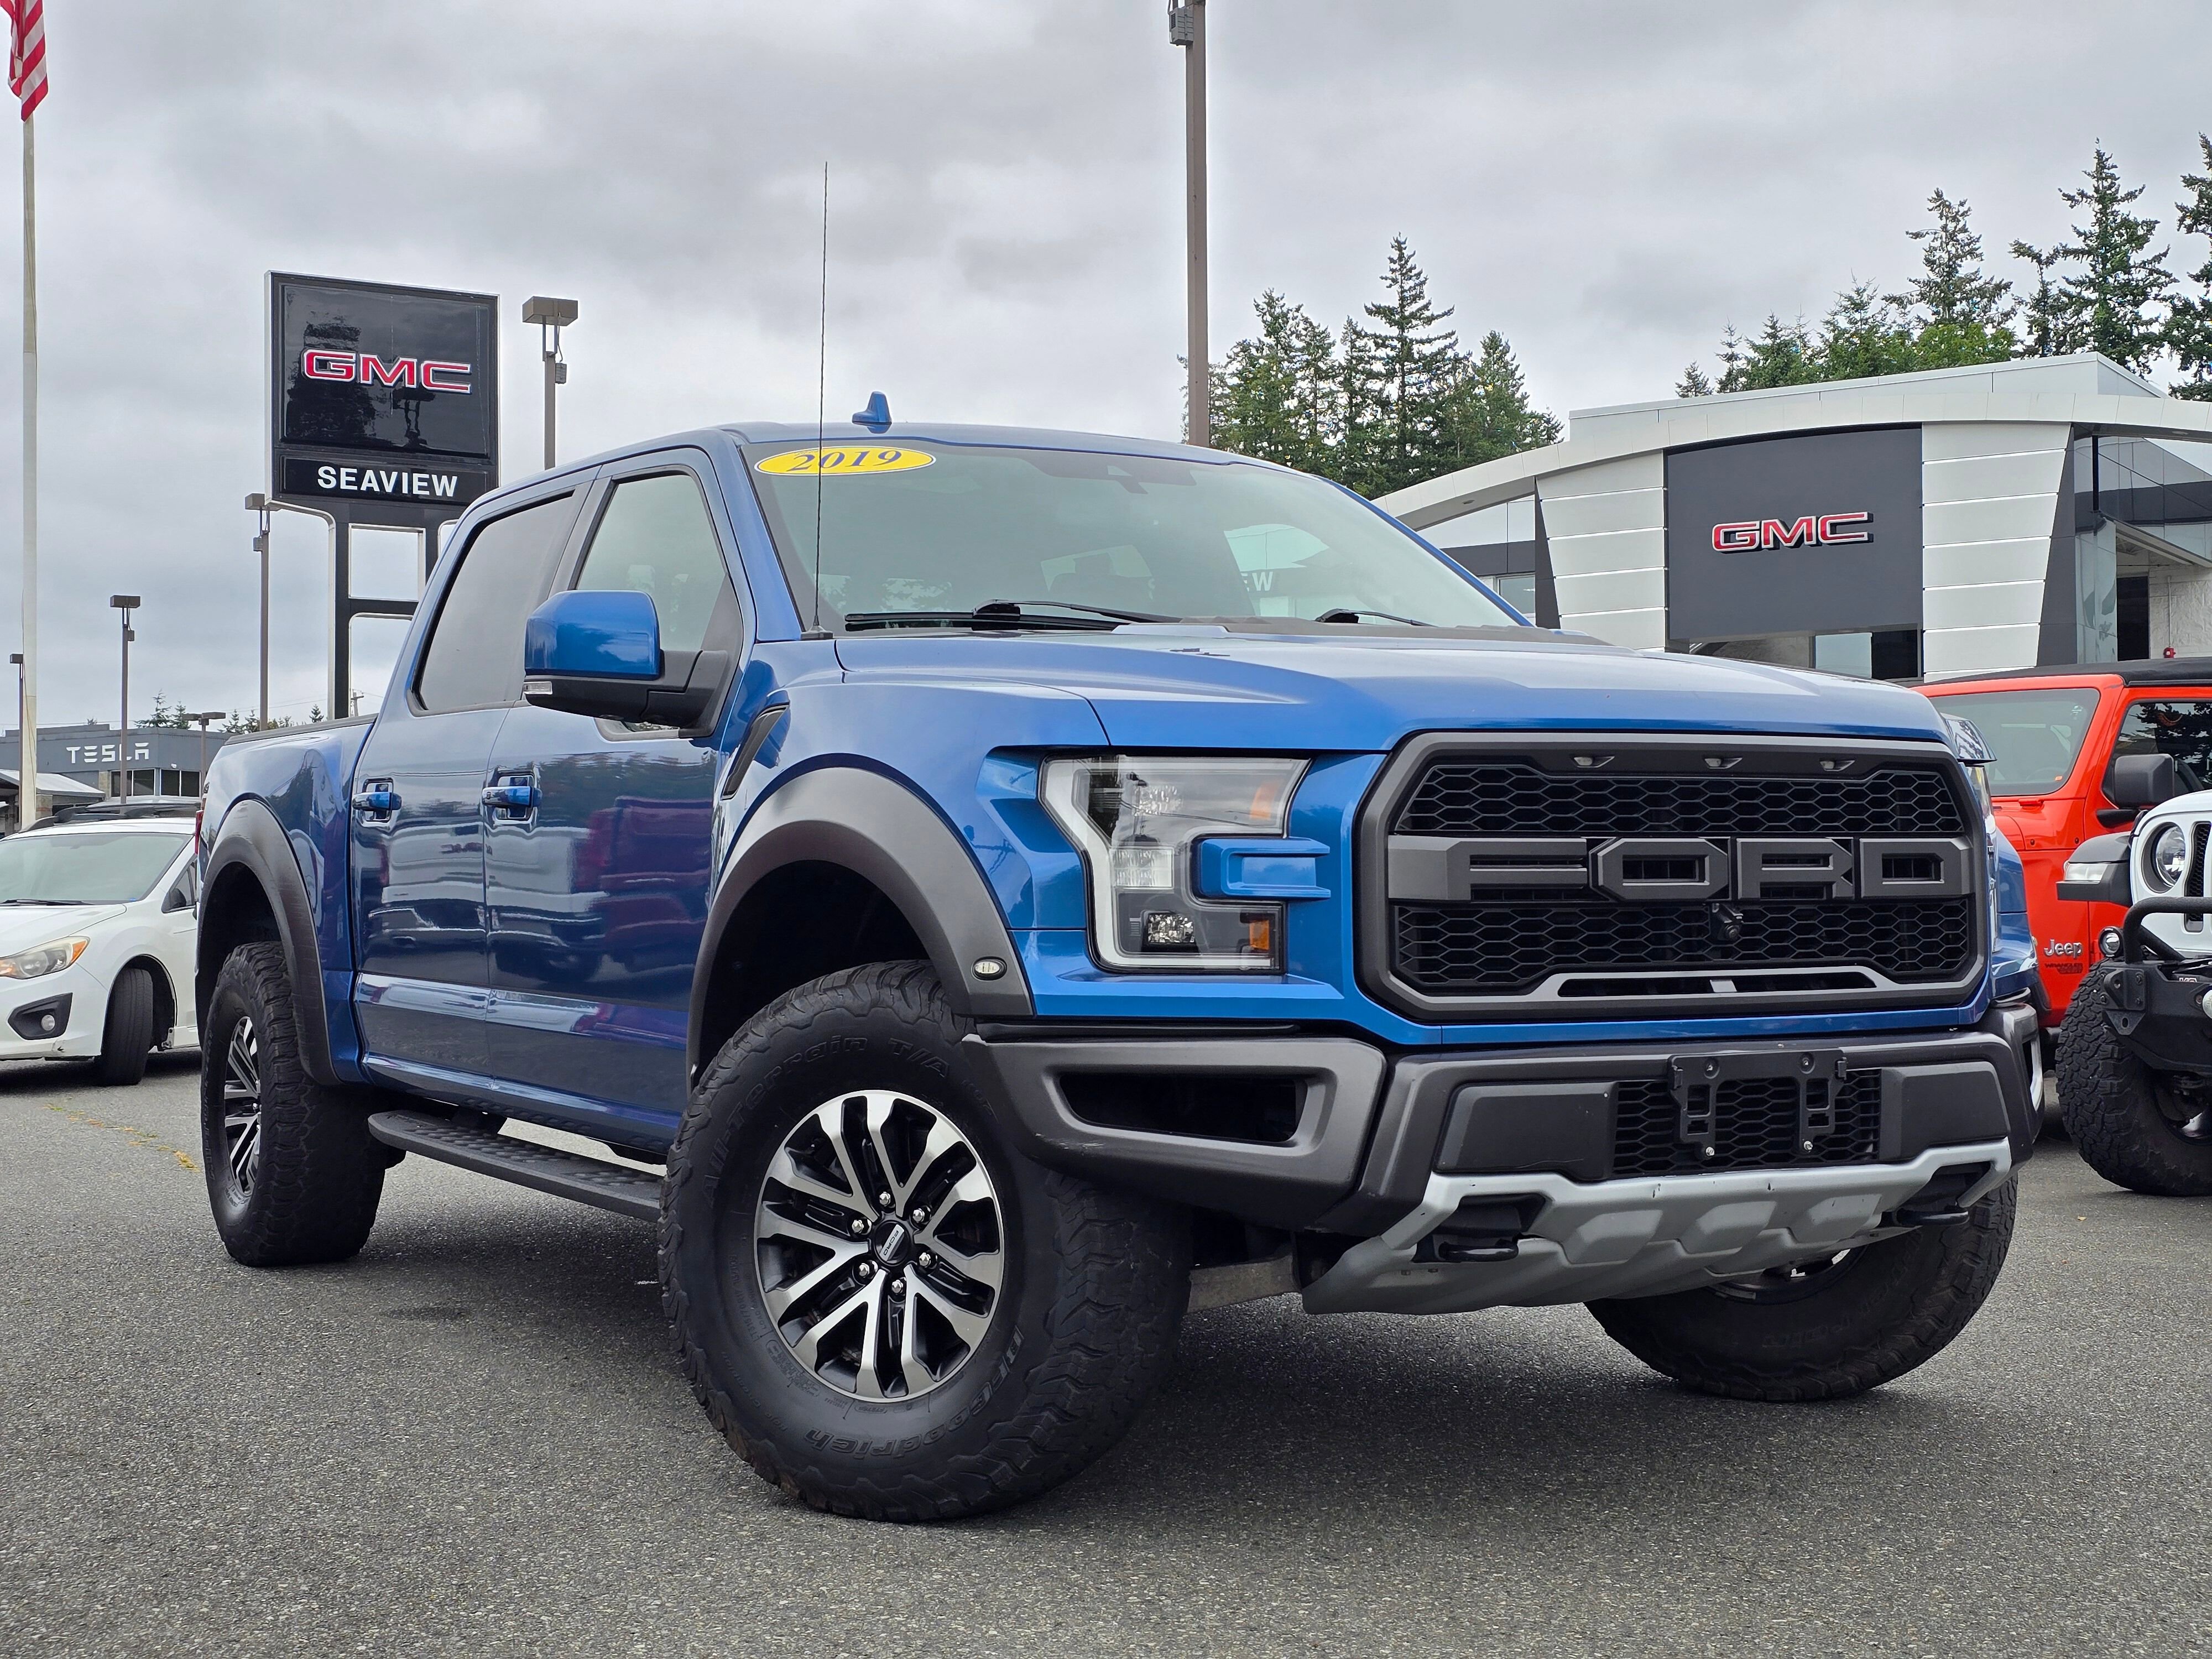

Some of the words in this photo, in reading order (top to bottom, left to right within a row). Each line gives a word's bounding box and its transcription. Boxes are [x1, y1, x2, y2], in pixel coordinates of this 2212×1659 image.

[301, 348, 472, 394] GMC
[786, 450, 902, 472] 2019
[317, 466, 458, 497] SEAVIEW
[1712, 512, 1872, 554] GMC
[1389, 836, 1971, 904] FORD
[2043, 938, 2083, 959] Jeep
[883, 1230, 899, 1256] FORD
